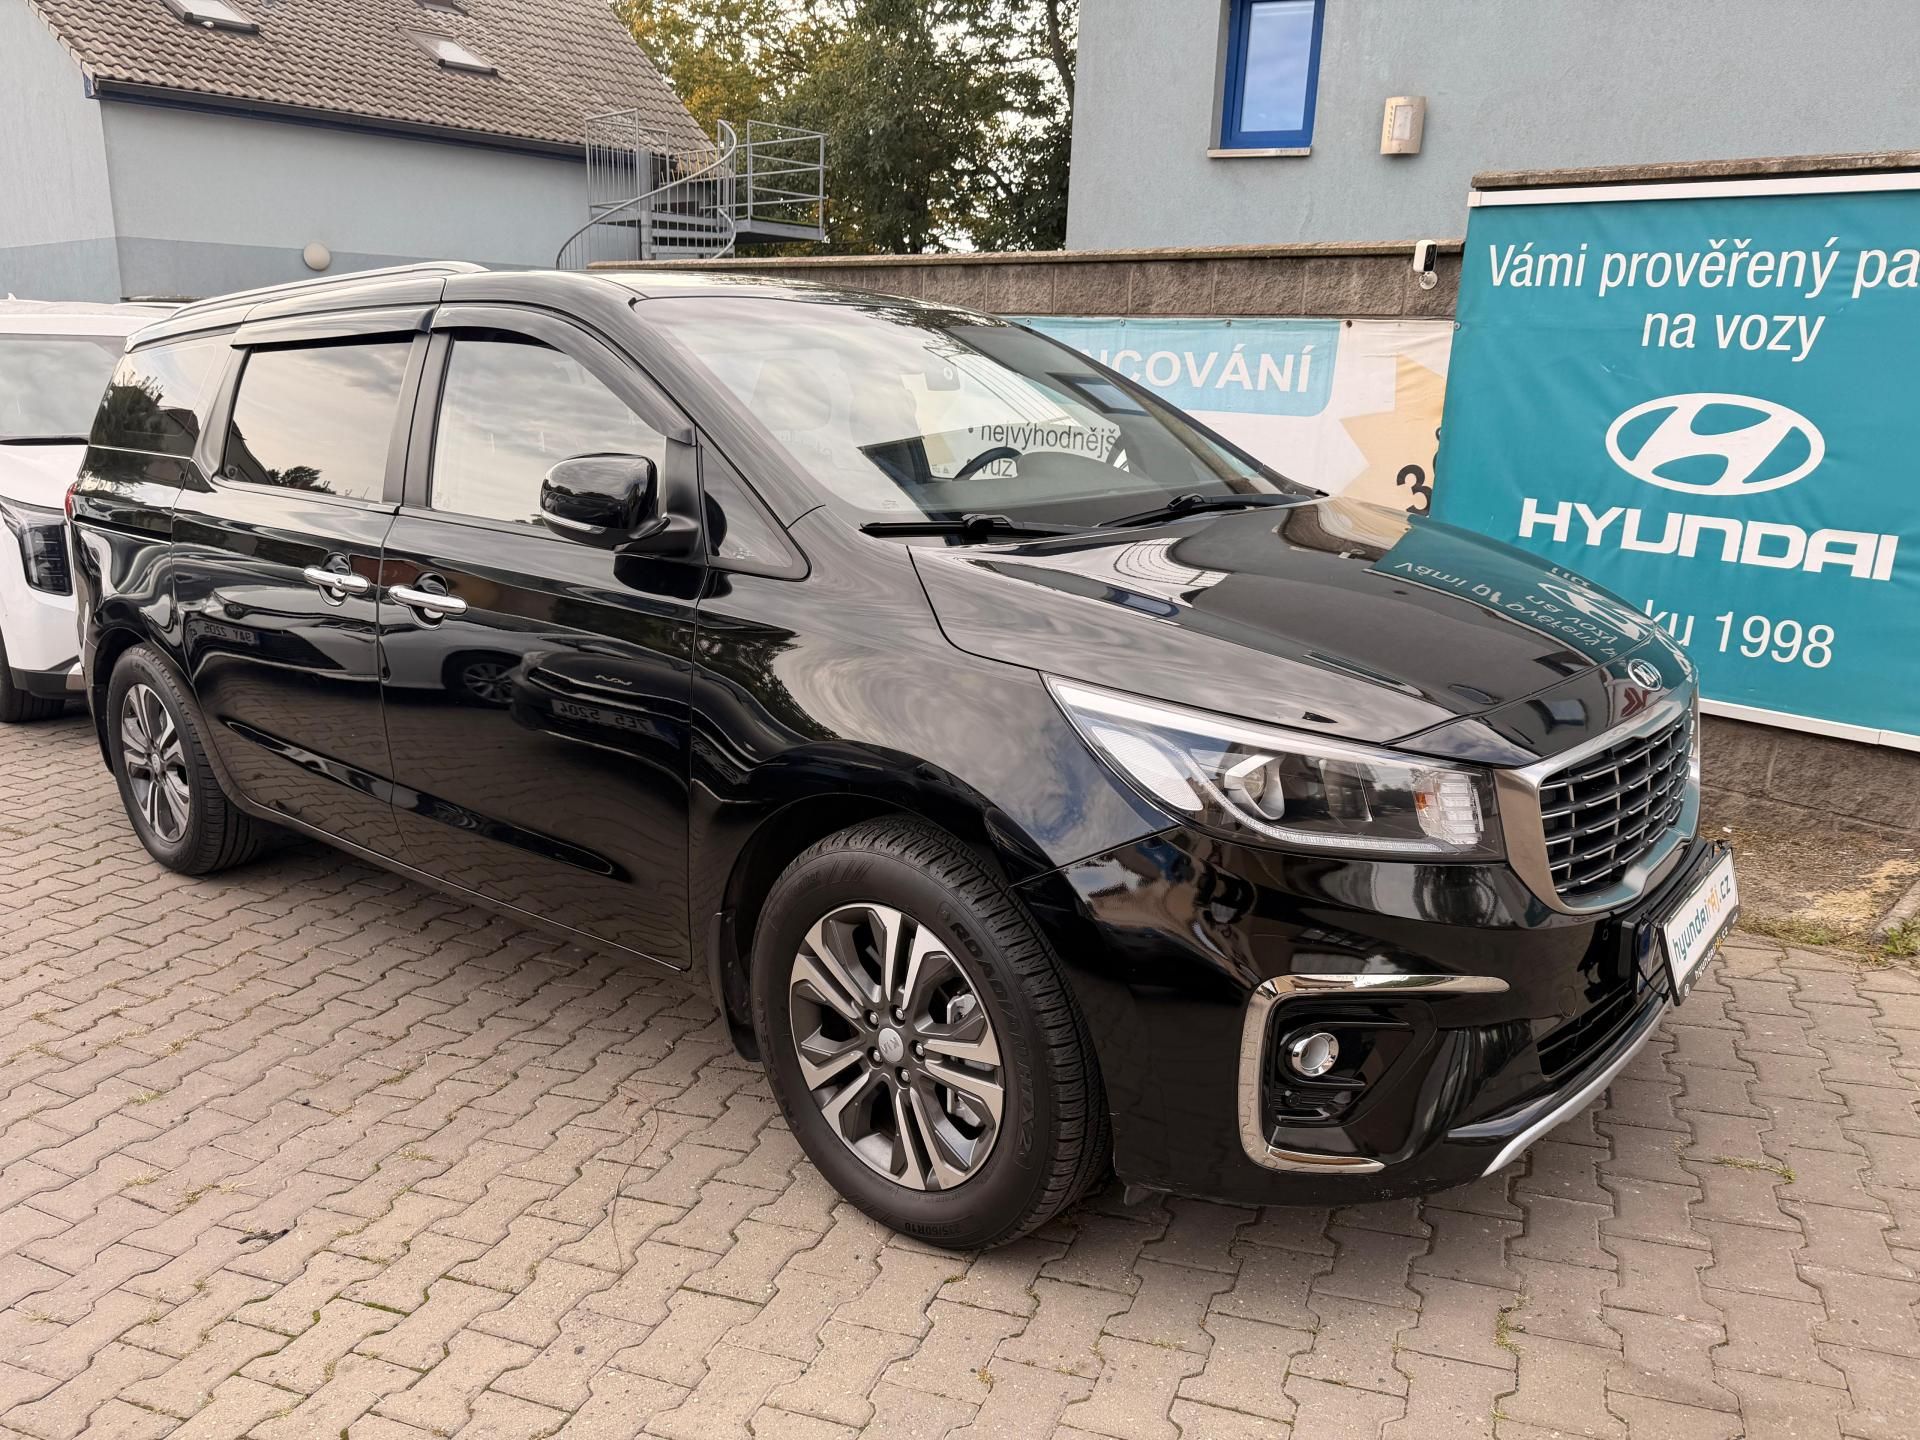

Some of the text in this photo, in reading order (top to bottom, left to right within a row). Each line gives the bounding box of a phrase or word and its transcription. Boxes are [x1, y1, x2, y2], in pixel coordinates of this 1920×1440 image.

[1489, 236, 1920, 299] Vámi prověřený pa
[1641, 312, 1826, 362] na vozy
[1517, 497, 1900, 583] HYUNDAI
[1715, 611, 1836, 669] 1998
